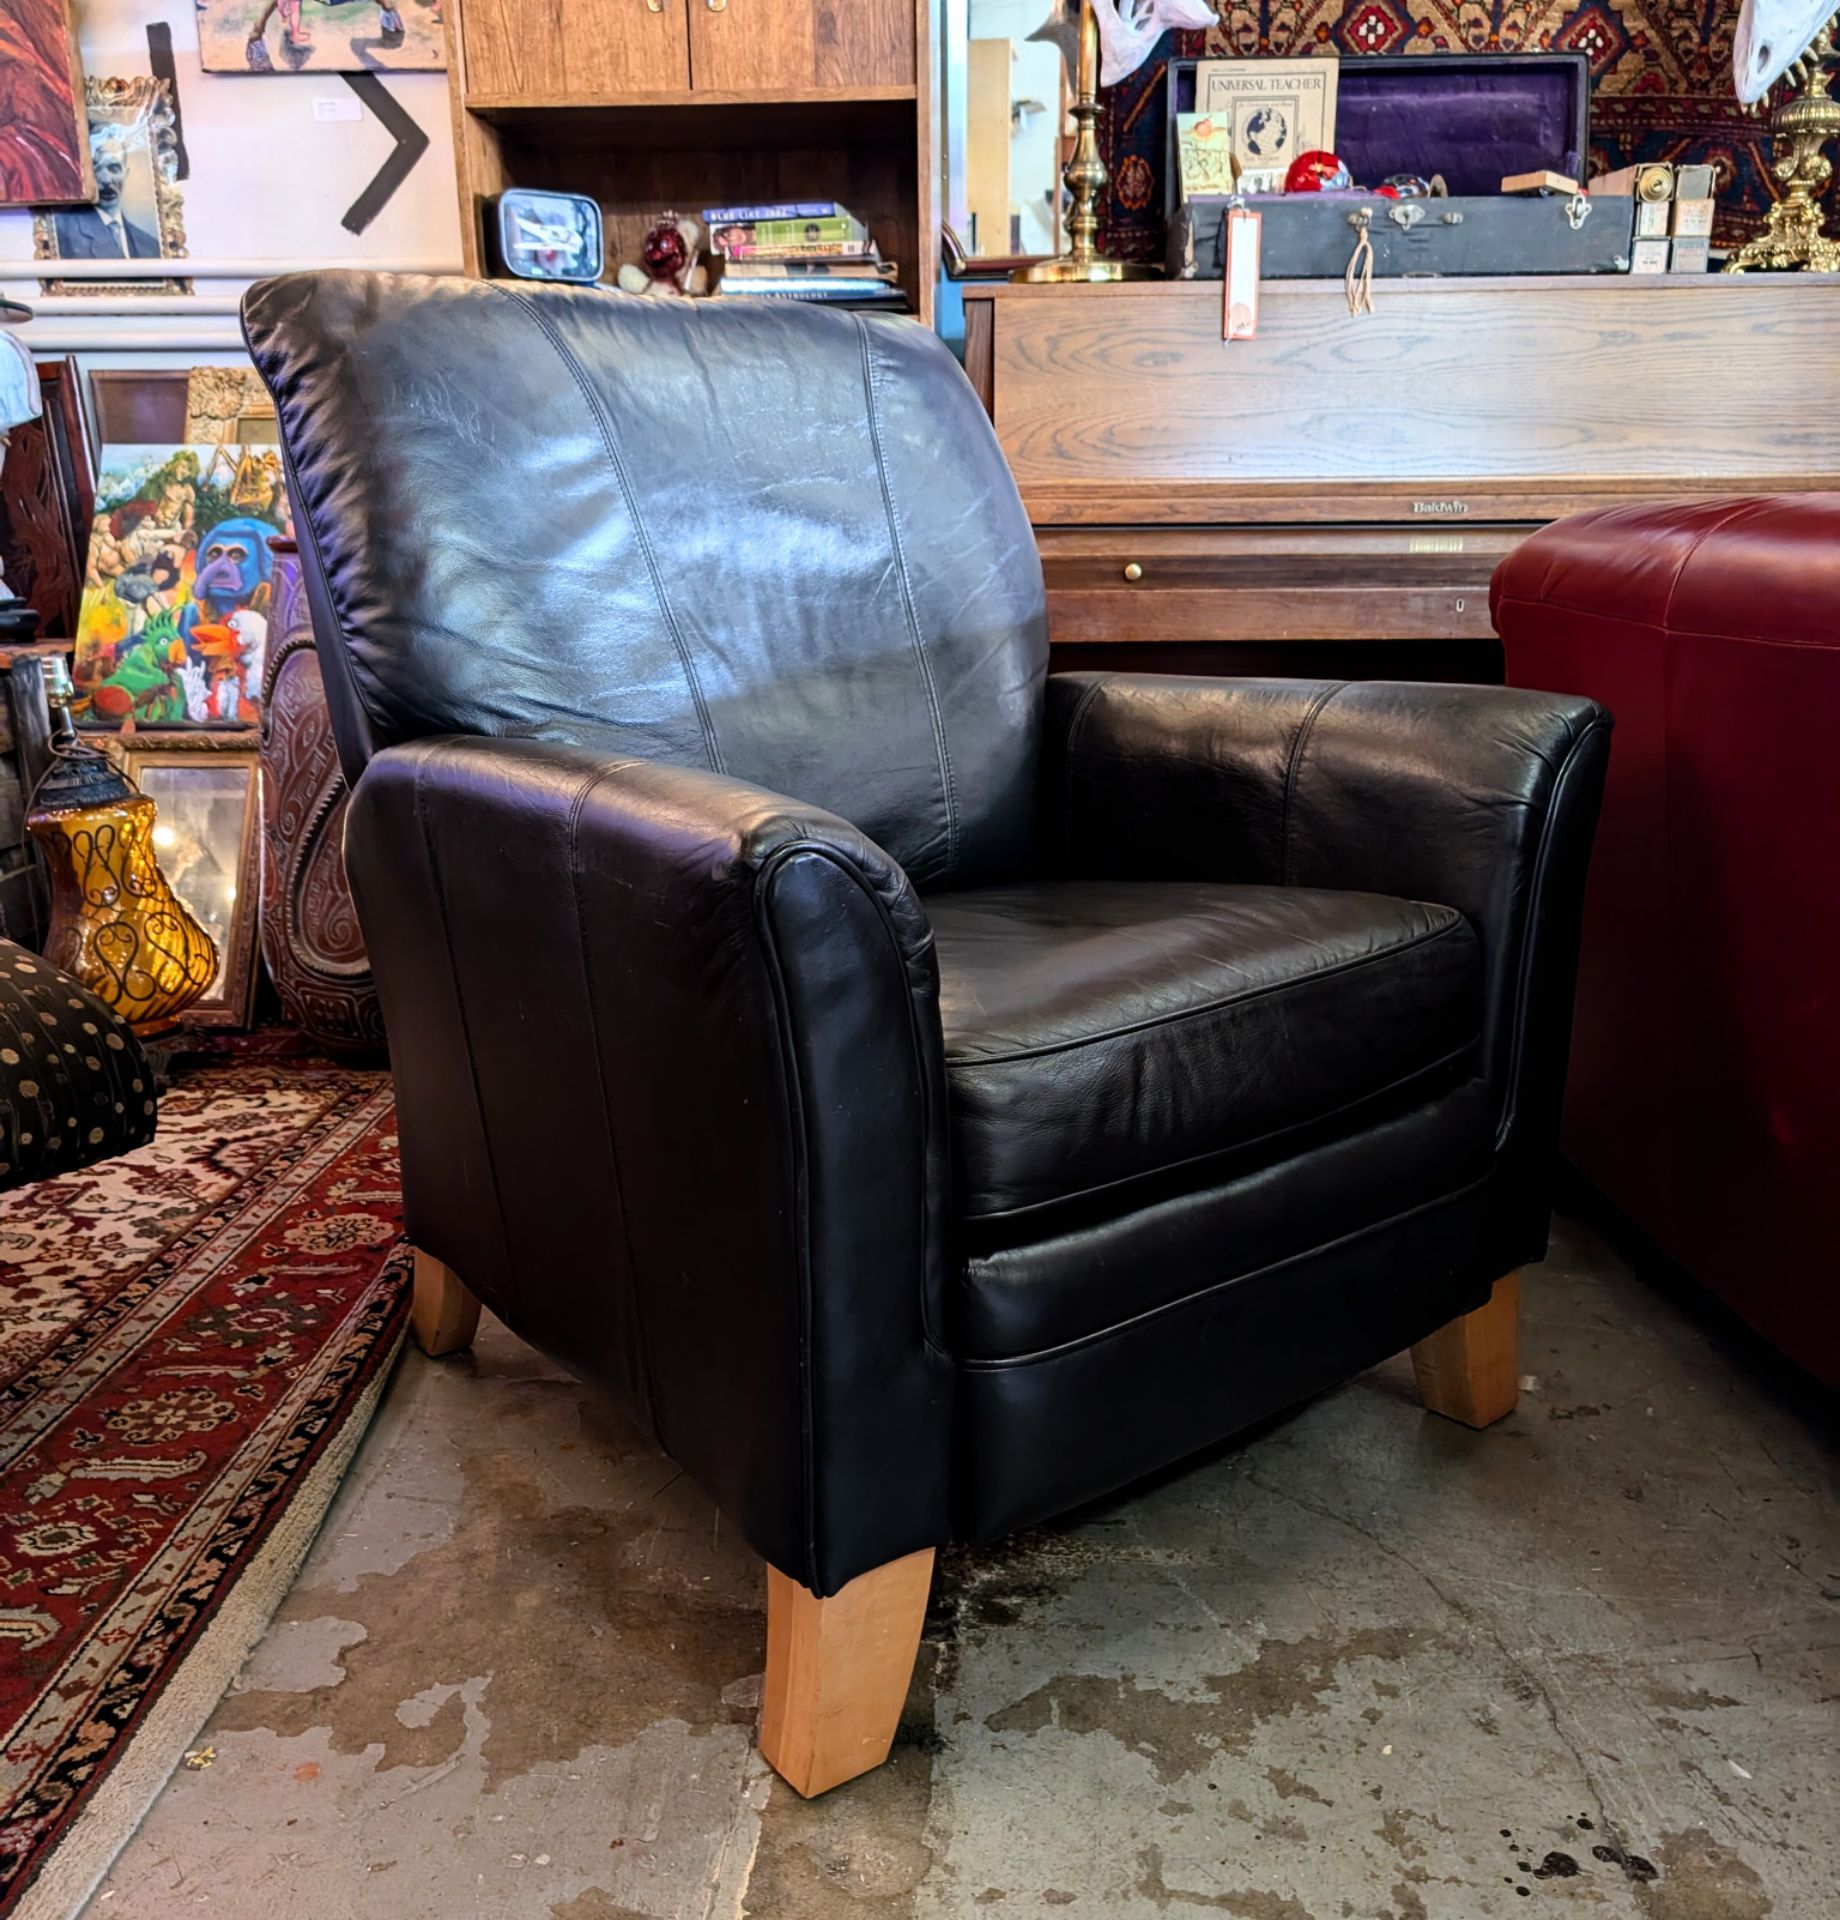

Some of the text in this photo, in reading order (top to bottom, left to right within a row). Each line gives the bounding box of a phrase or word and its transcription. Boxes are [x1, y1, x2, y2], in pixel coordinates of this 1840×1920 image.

[1211, 78, 1322, 92] UNIVERSAL TEACHER
[1412, 500, 1469, 513] Baldwin
